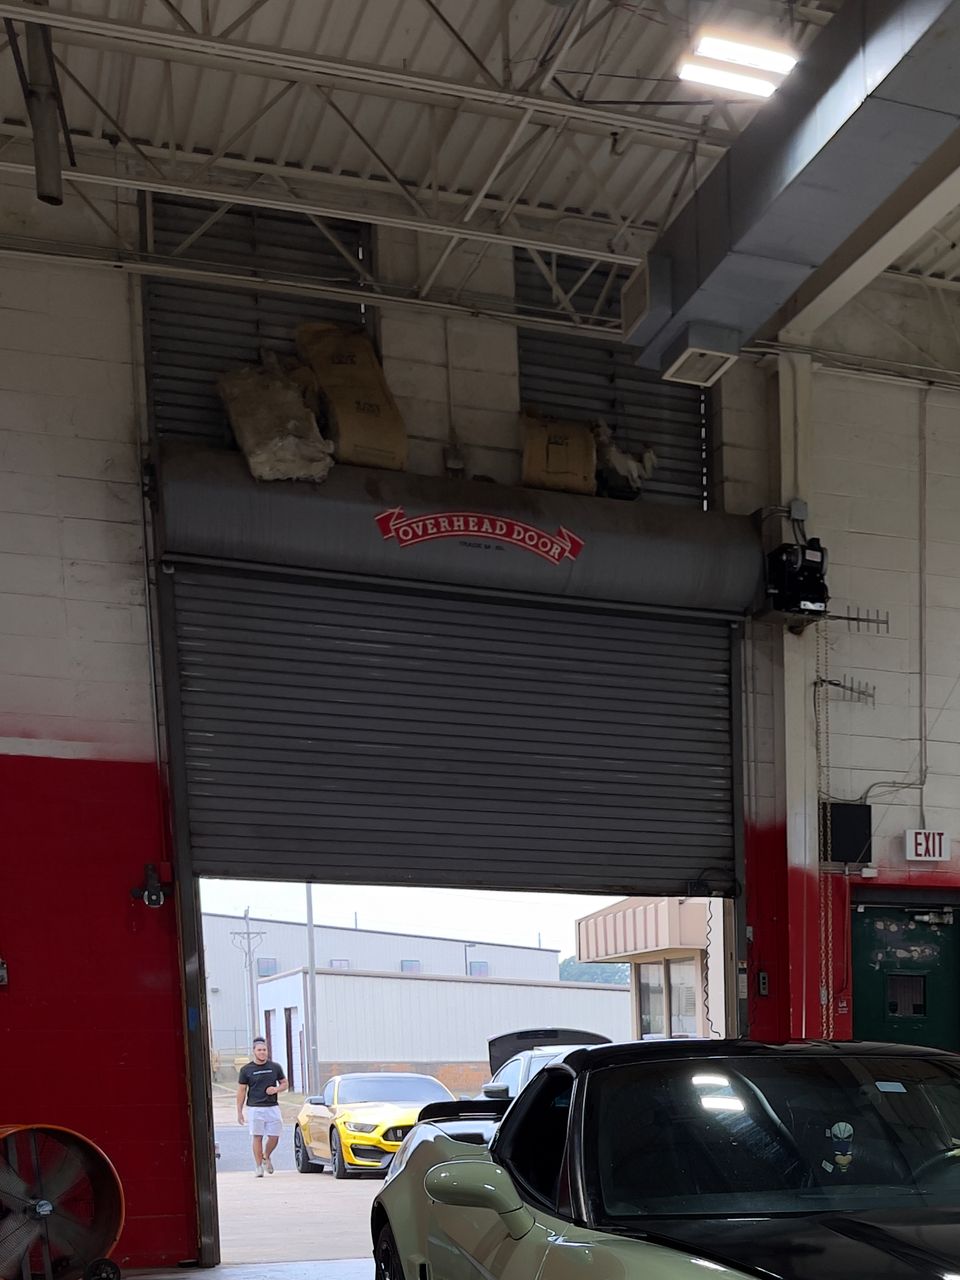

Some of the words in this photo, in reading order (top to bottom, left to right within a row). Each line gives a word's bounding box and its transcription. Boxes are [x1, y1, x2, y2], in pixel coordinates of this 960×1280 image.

[399, 516, 507, 541] OVERHEAD
[511, 525, 562, 560] DOOR
[914, 831, 944, 858] EXIT
